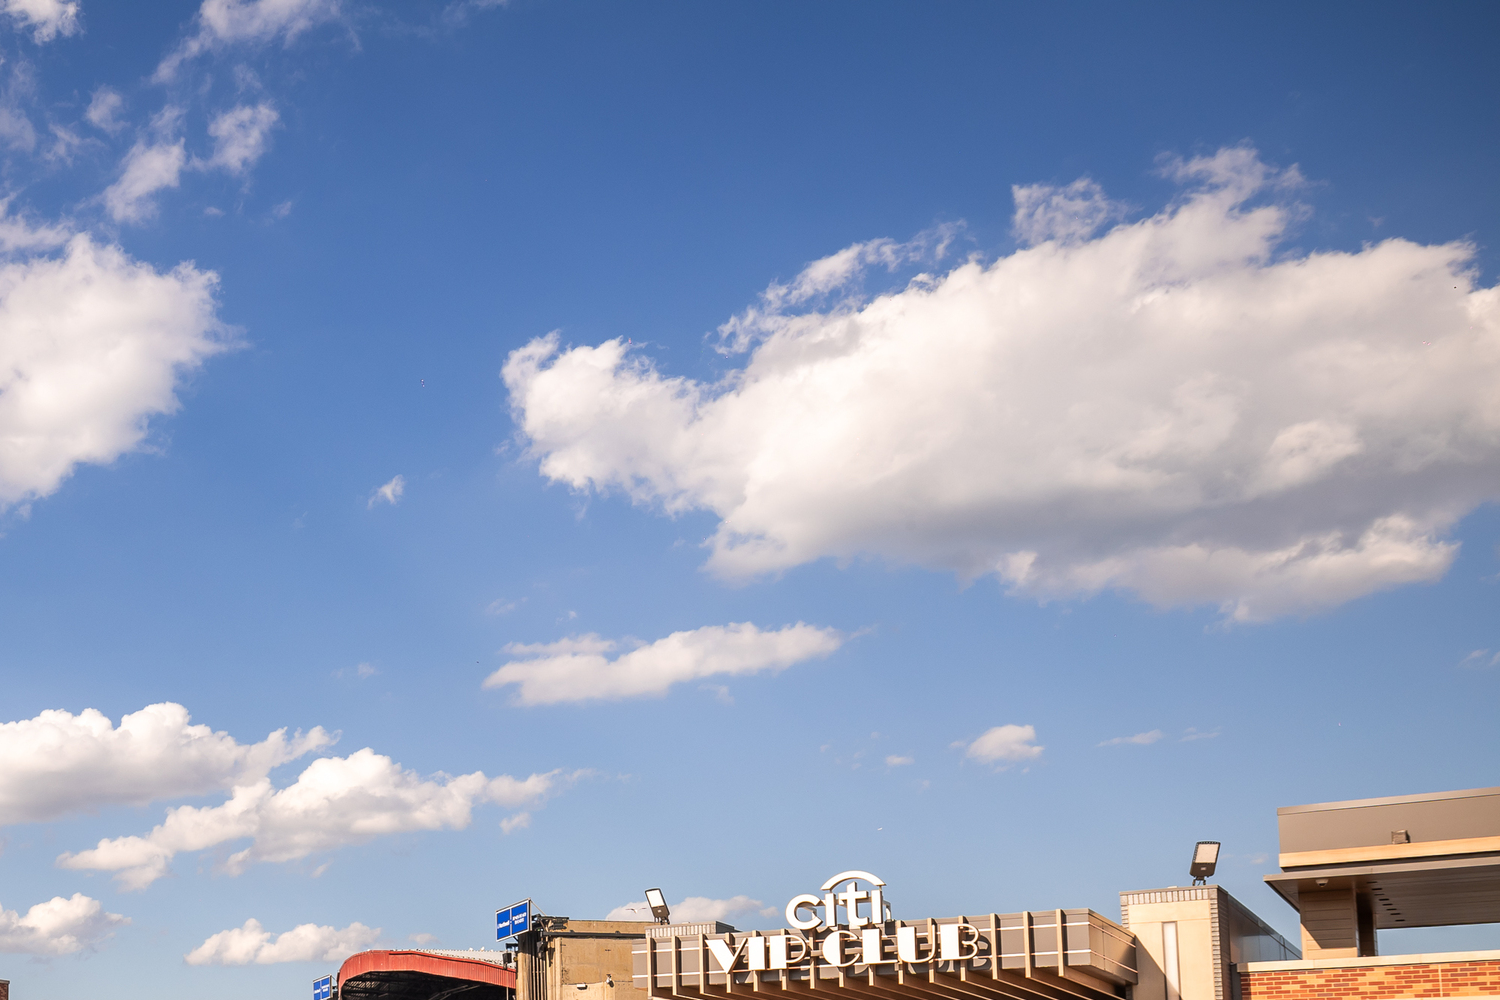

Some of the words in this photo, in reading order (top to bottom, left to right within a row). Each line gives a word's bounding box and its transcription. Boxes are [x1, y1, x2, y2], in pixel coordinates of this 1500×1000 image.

[785, 874, 886, 930] citi
[705, 934, 807, 974] VIP
[822, 923, 980, 968] CLUB
